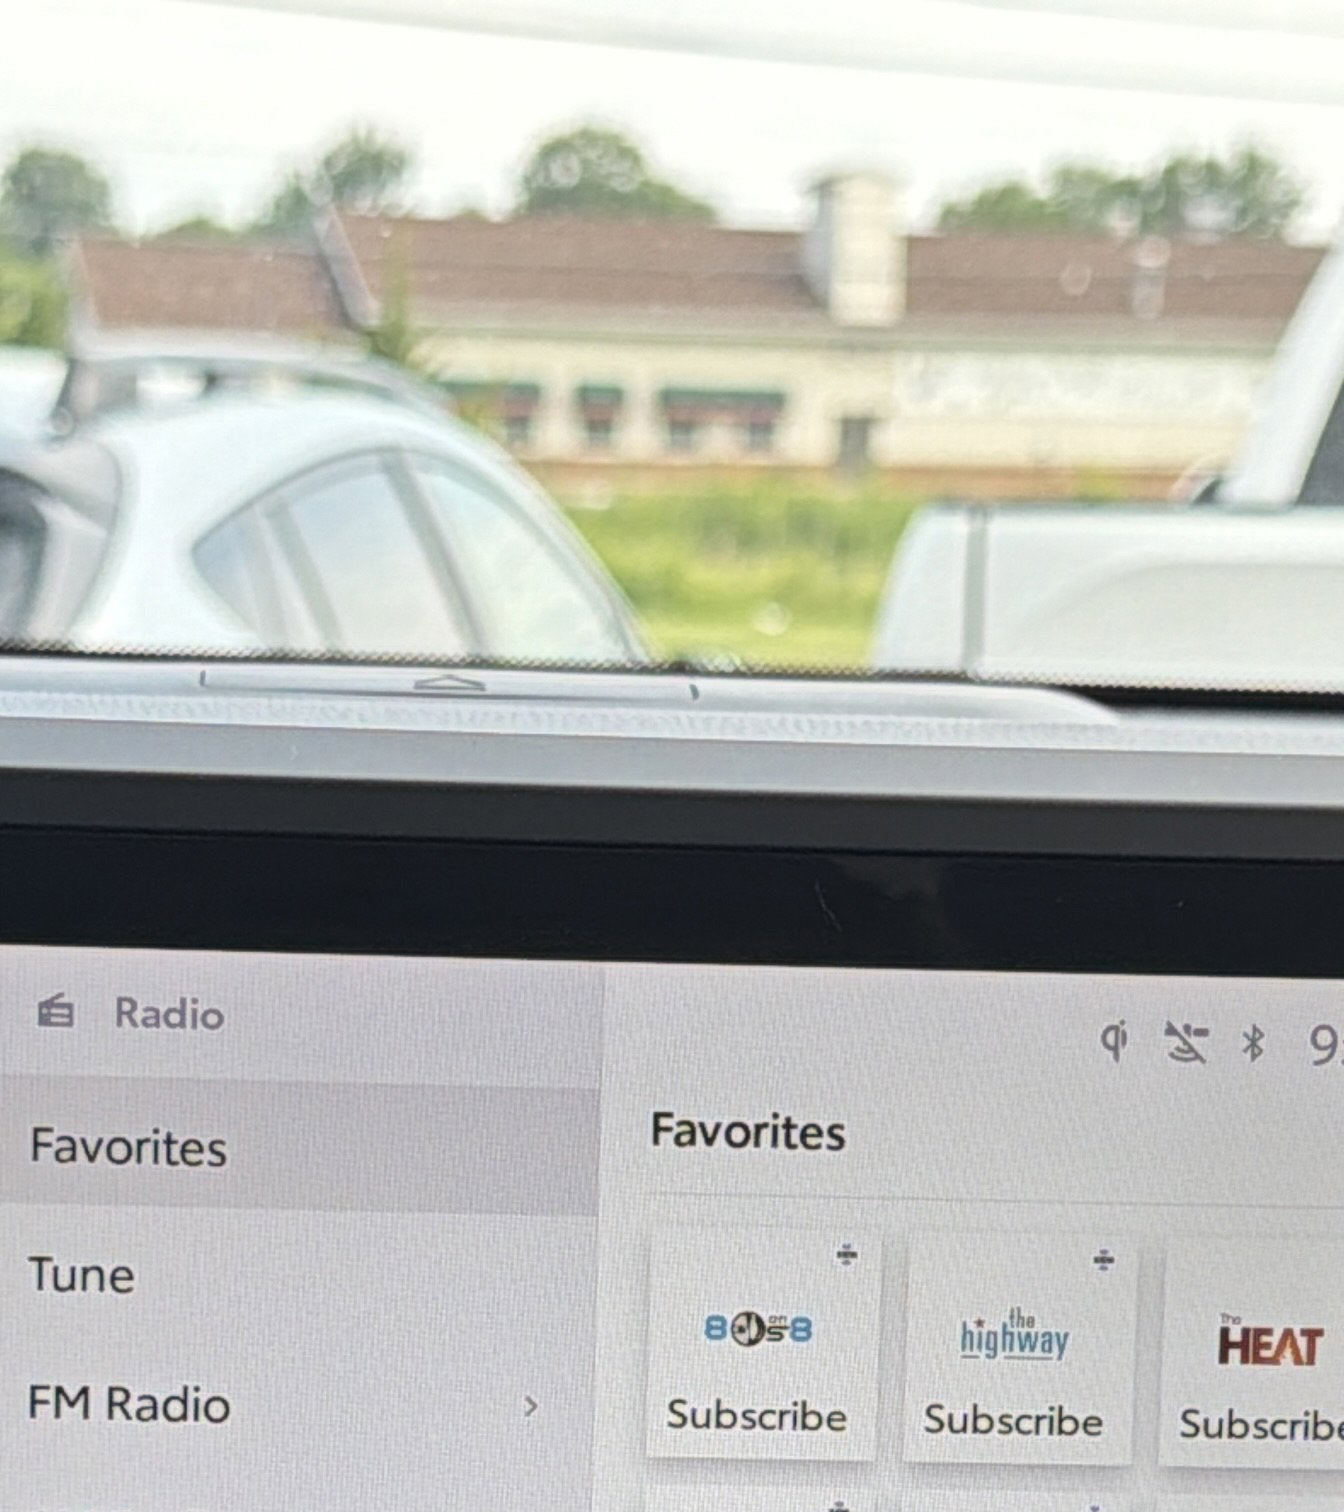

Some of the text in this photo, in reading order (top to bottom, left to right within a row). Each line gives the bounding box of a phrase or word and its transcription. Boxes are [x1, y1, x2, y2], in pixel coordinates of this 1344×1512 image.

[116, 996, 225, 1031] Radio
[32, 1126, 227, 1168] Favorites
[652, 1111, 846, 1152] Favorites
[27, 1255, 135, 1294] Tune
[1009, 1306, 1036, 1330] the
[960, 1321, 1070, 1360] highway
[1217, 1327, 1325, 1367] HEAT
[29, 1384, 231, 1424] FM Radio
[667, 1398, 847, 1433] Subscribe
[924, 1403, 1104, 1437] Subscribe
